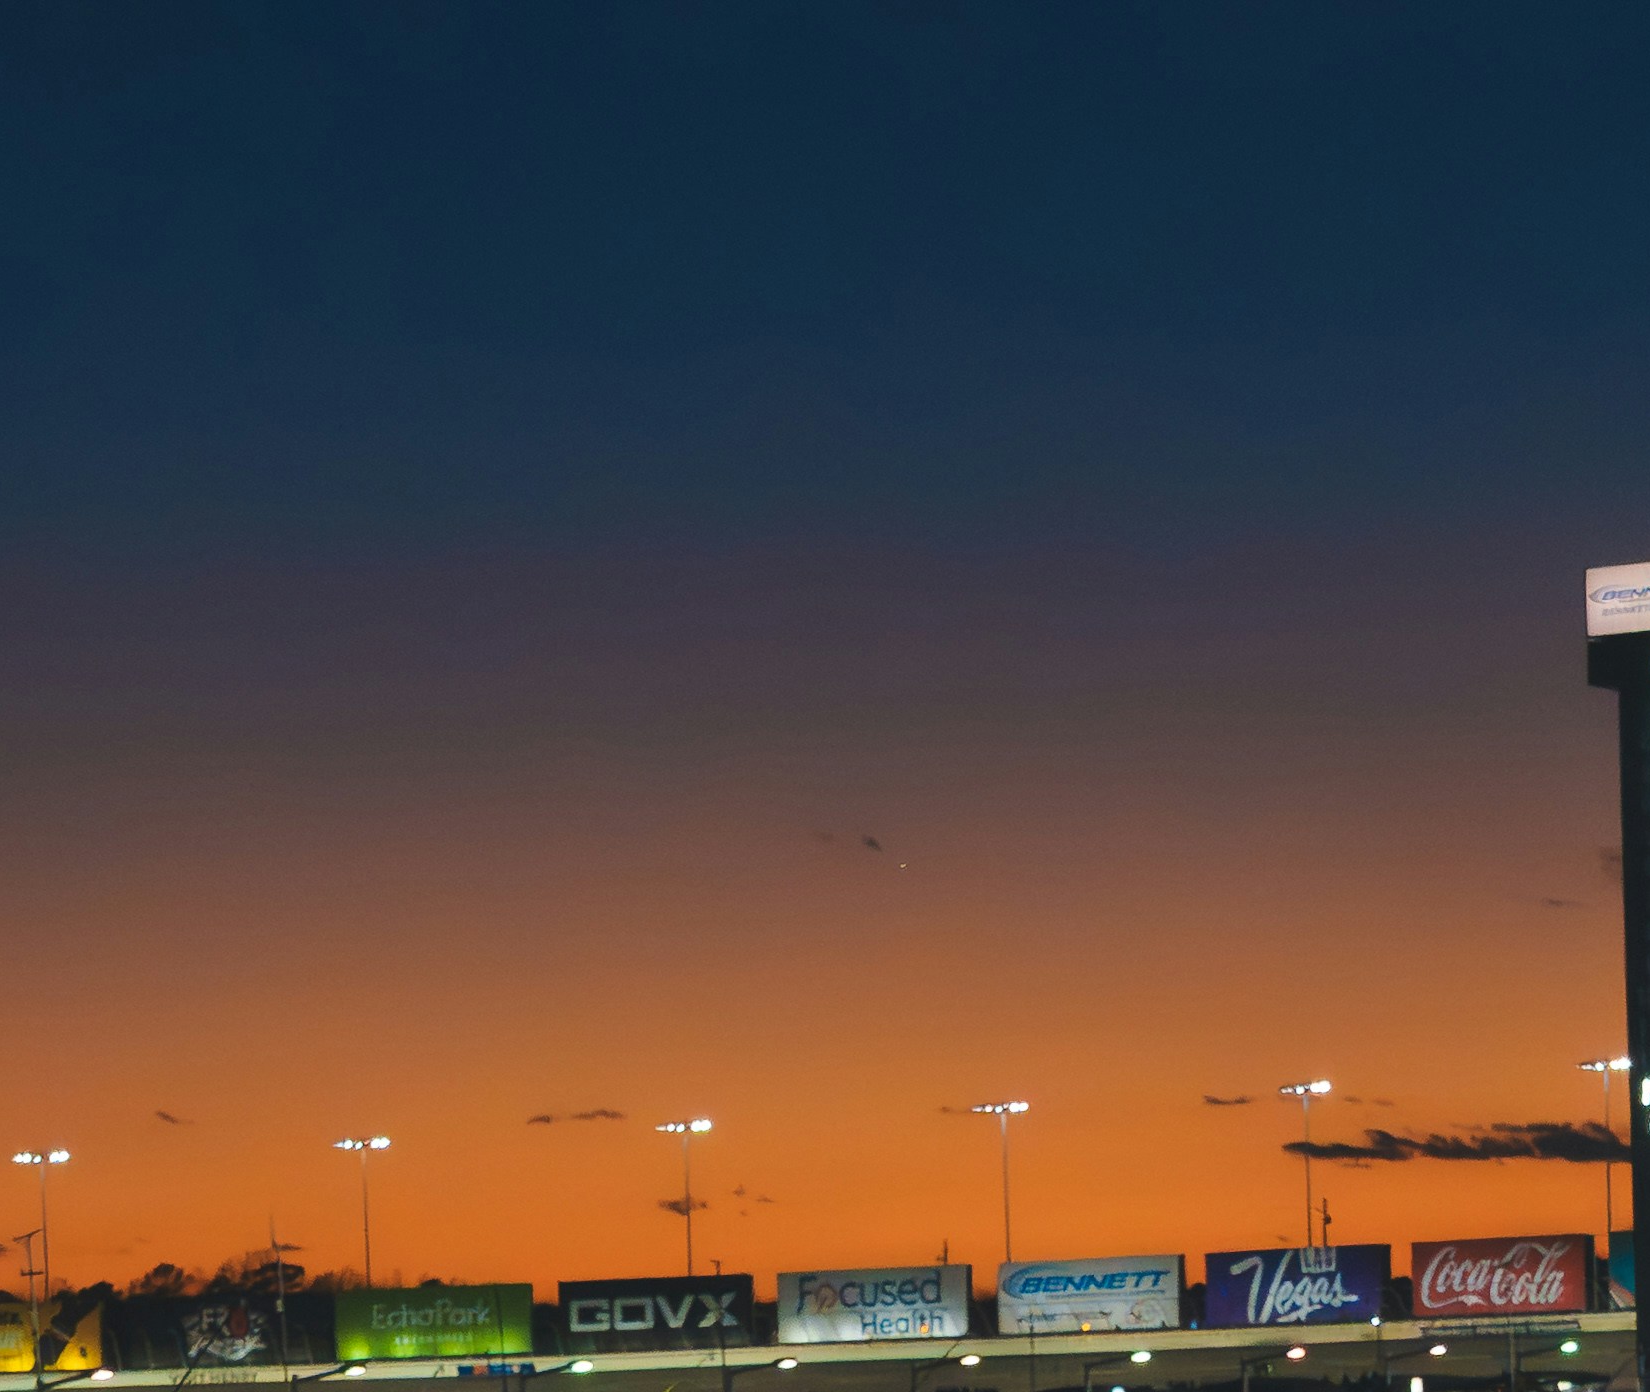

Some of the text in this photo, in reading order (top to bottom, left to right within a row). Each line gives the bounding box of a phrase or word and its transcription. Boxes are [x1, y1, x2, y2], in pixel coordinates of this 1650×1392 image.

[797, 1270, 942, 1314] Focused
[1020, 1271, 1171, 1293] BENNETT
[1230, 1249, 1359, 1324] Vegas
[371, 1299, 491, 1330] EchoPark
[570, 1291, 739, 1333] GOVX
[860, 1311, 944, 1337] Health
